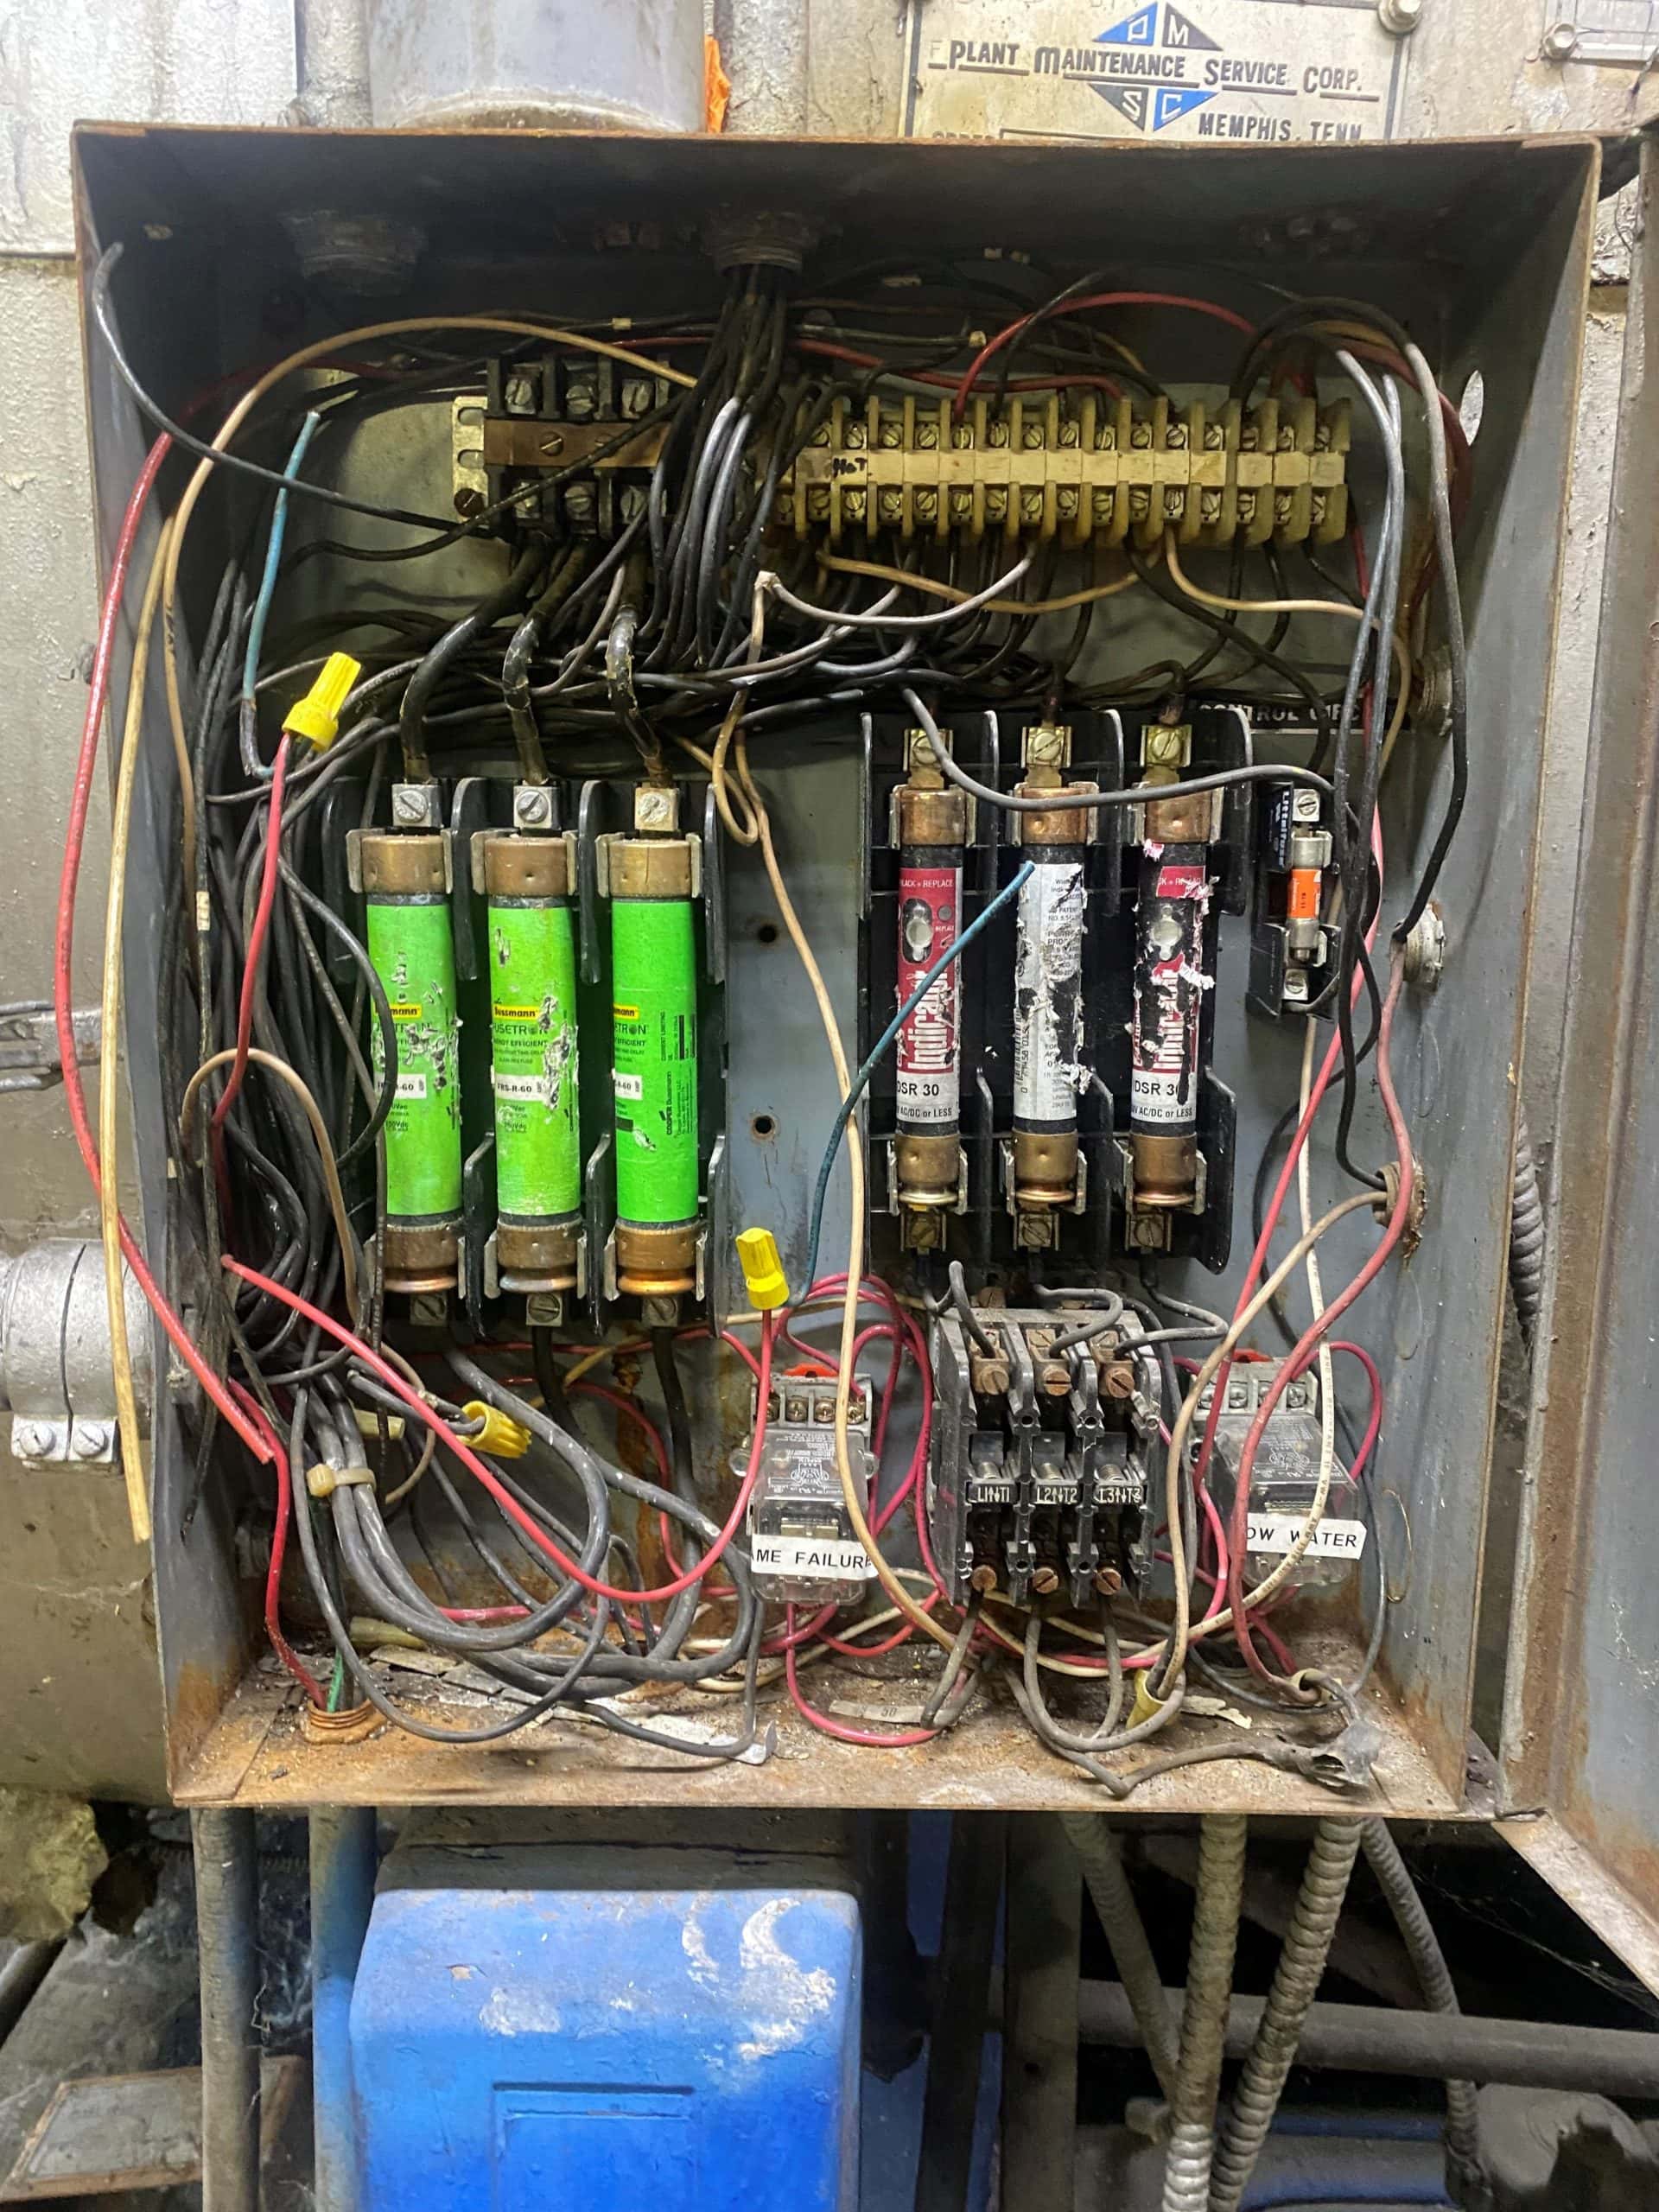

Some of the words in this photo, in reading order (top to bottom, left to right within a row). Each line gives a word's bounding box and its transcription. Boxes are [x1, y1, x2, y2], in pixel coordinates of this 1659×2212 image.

[950, 40, 1020, 70] PLANT
[1033, 46, 1185, 79] MAINTENANCE
[1204, 58, 1287, 86] SERVICE
[1303, 66, 1362, 93] CORP.
[923, 879, 954, 888] REPLACE
[923, 1084, 939, 1096] 30
[933, 1107, 952, 1118] LESS
[1139, 1107, 1163, 1118] AC/DC
[1176, 1107, 1192, 1118] LESS
[752, 1548, 782, 1563] ME
